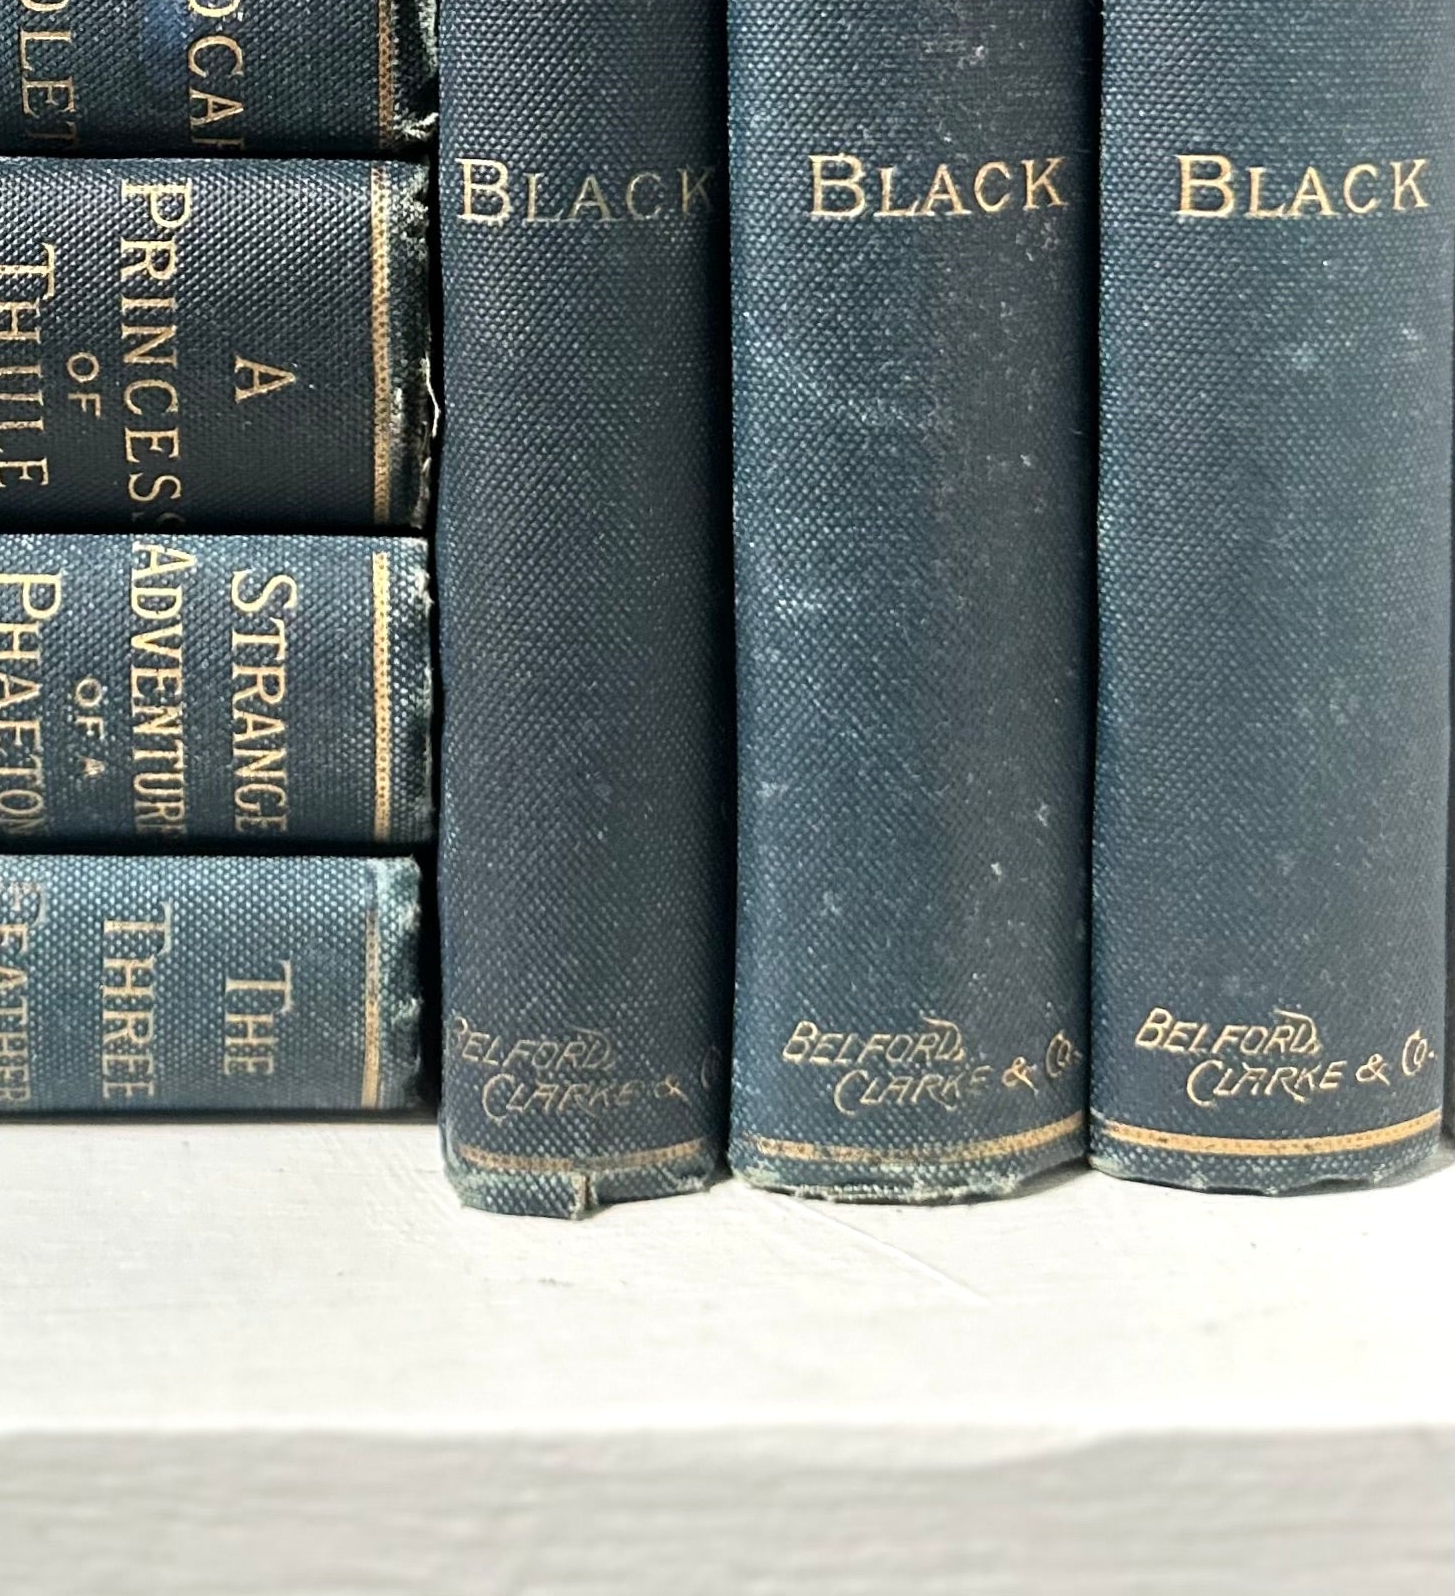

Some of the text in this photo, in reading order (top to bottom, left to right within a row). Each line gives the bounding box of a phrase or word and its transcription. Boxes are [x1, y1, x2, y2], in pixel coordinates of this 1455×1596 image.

[456, 157, 714, 226] BLACK
[807, 154, 1068, 220] BLACK
[1175, 152, 1433, 218] BLACK
[66, 350, 102, 418] OF
[233, 355, 297, 403] A
[73, 678, 105, 742] OF
[231, 568, 297, 835] STRANGE
[101, 902, 173, 1100] THREE
[223, 960, 294, 1077] THE
[1001, 1056, 1039, 1096] &
[1186, 1059, 1348, 1108] CLARKE
[1355, 1053, 1390, 1086] &
